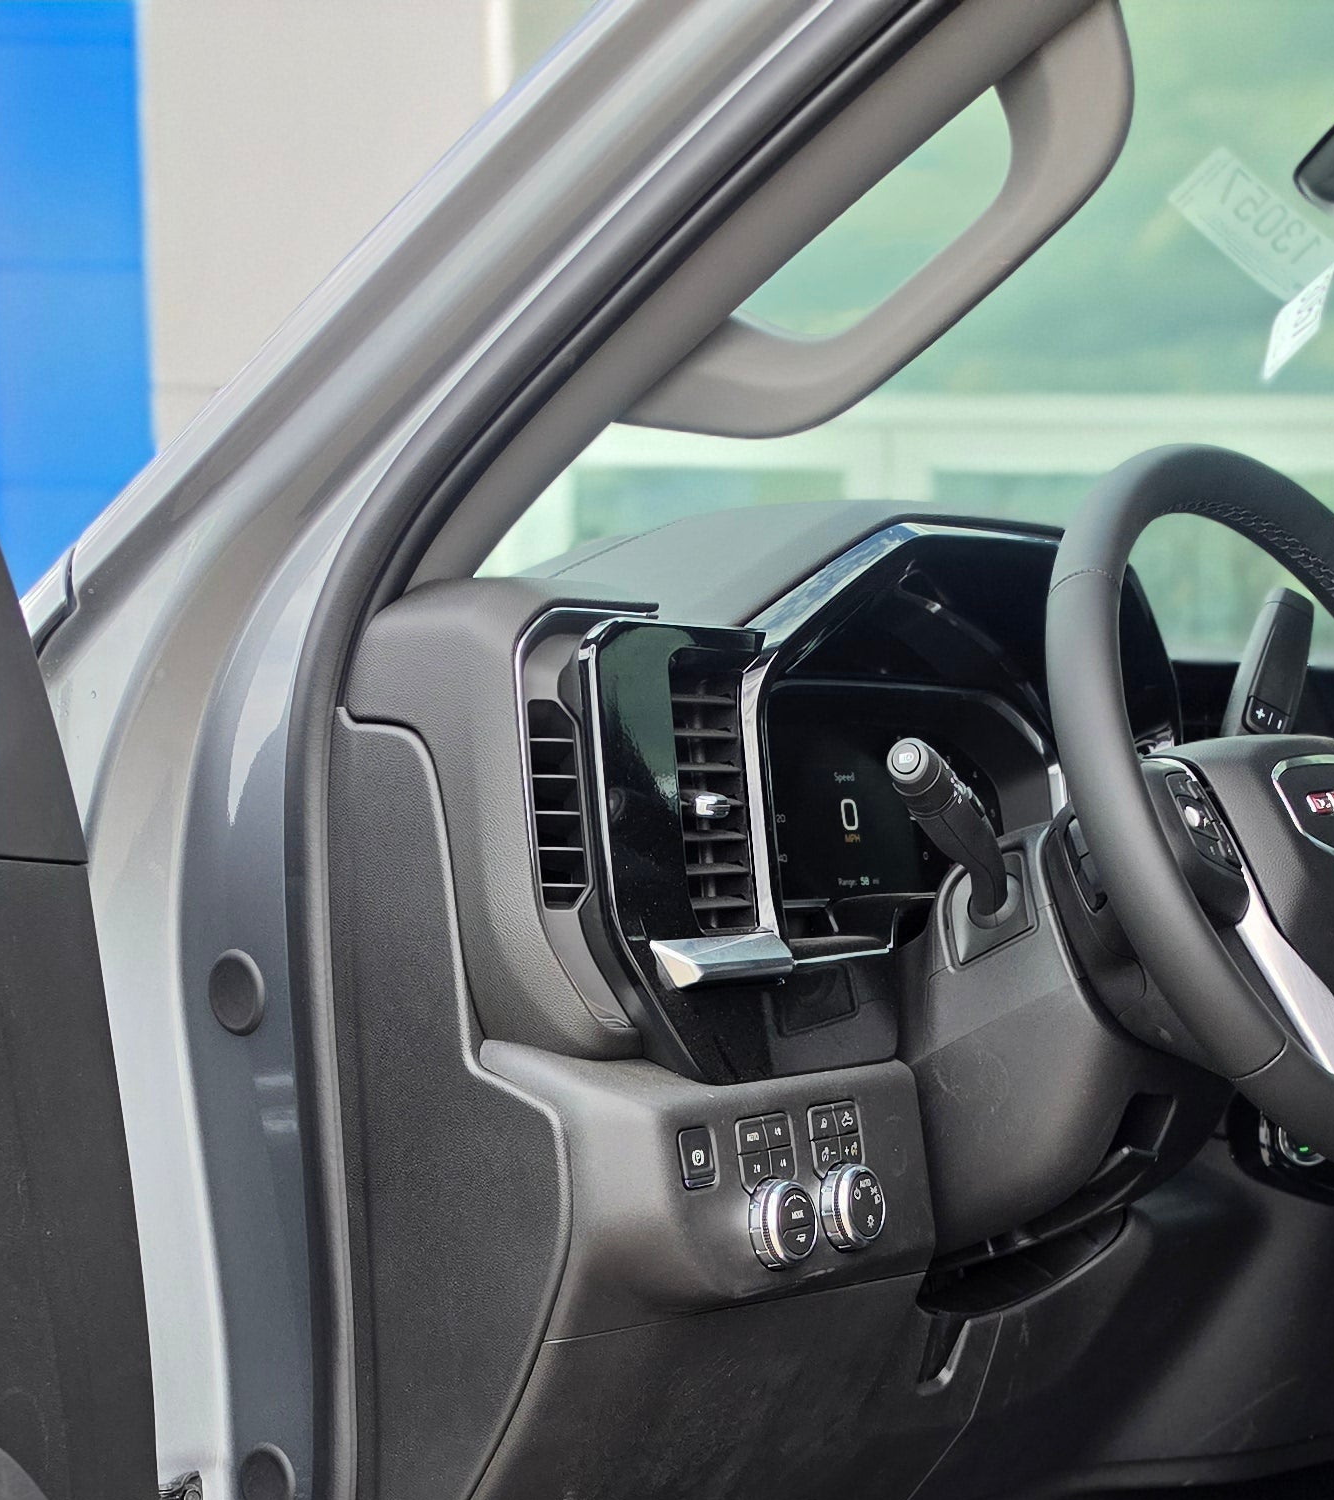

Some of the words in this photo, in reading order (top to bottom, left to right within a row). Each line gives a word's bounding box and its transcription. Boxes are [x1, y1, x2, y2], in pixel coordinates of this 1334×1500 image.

[833, 771, 856, 783] Speed
[775, 814, 786, 823] 20
[840, 798, 859, 831] 0
[844, 833, 861, 843] MPH
[746, 1132, 760, 1142] AUTO
[859, 1178, 871, 1188] AUTO
[791, 1209, 805, 1220] MODE
